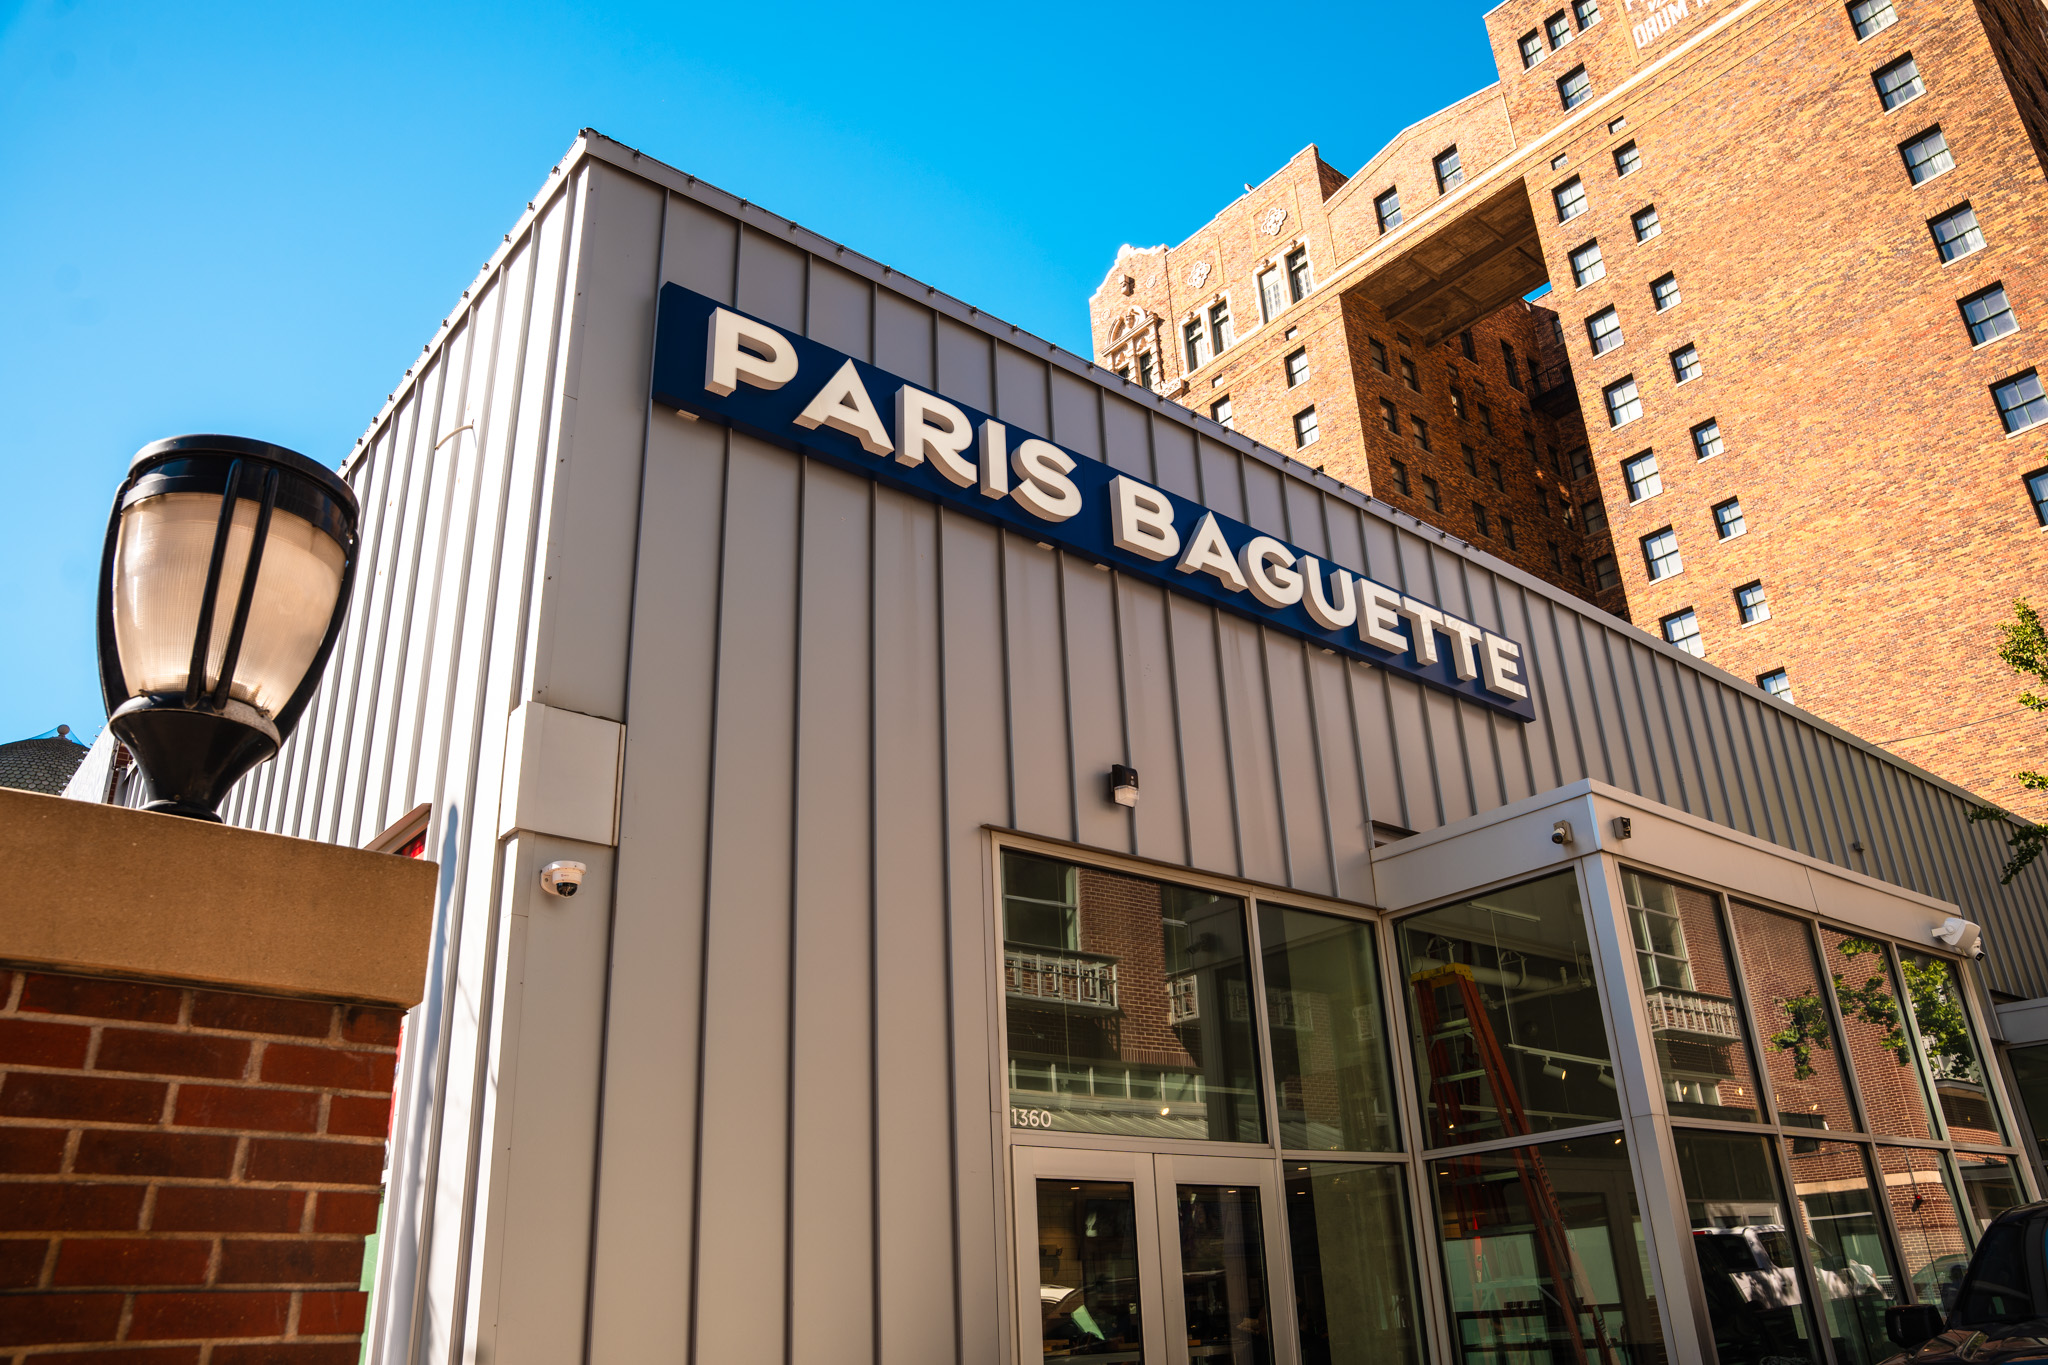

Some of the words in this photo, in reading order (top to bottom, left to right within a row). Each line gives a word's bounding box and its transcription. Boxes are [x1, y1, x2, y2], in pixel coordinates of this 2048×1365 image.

[1632, 0, 1689, 49] DRUM
[704, 307, 1083, 523] PARIS
[1109, 474, 1529, 701] BAGUETTE
[1011, 1108, 1052, 1128] 1360
